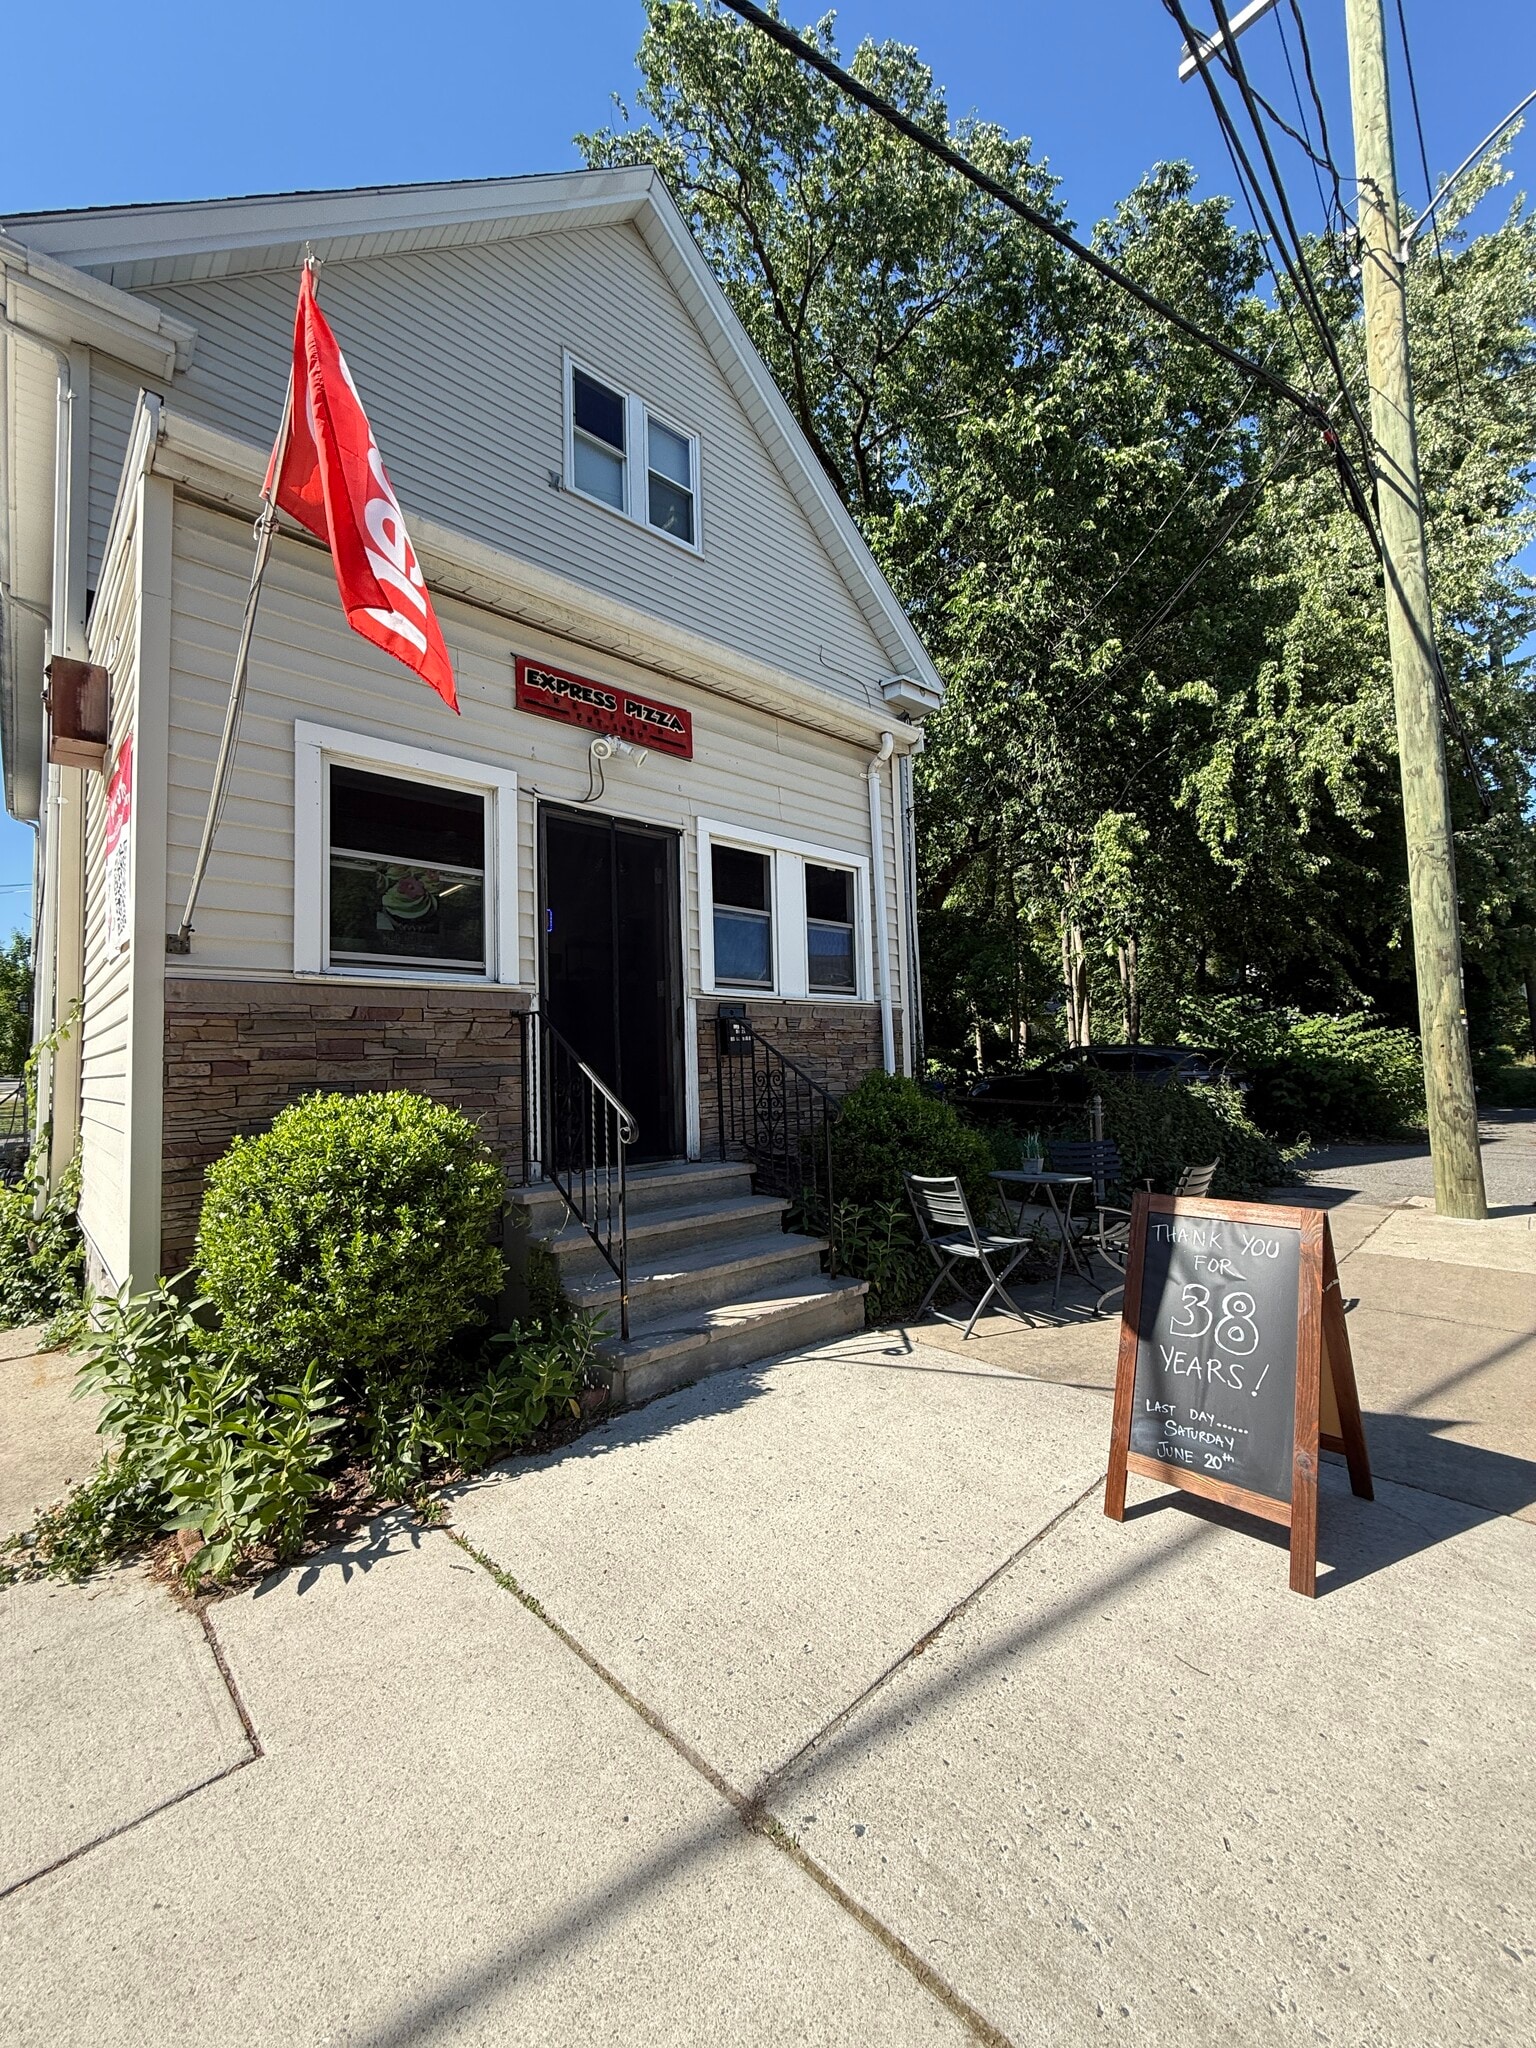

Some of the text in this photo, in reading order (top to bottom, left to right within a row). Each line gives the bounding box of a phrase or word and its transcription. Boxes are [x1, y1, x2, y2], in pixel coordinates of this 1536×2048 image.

[524, 666, 686, 734] EXPRESS PIZZA
[1151, 1224, 1280, 1259] THANK YOU
[1193, 1255, 1248, 1282] FOR
[1169, 1283, 1260, 1356] 38
[1145, 1398, 1177, 1417] LAST
[1164, 1420, 1235, 1451] SATURDAY
[1156, 1441, 1235, 1471] JUNE 20th
